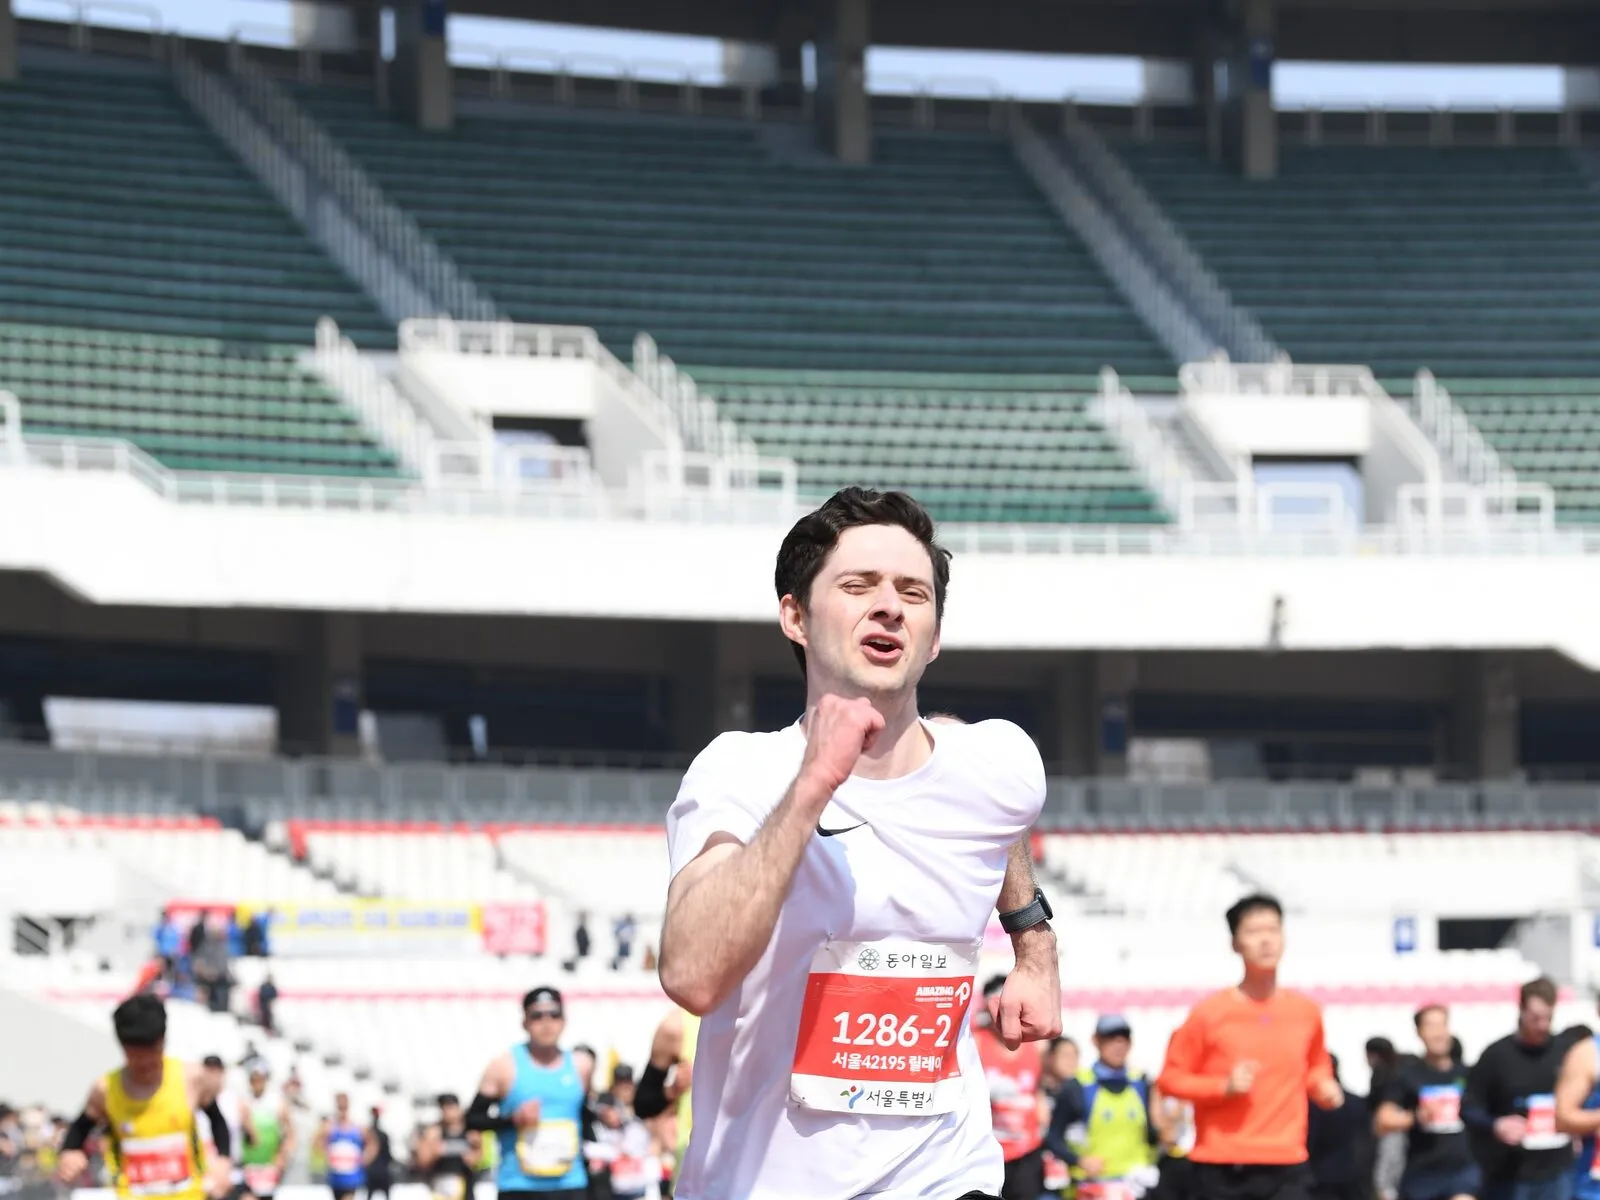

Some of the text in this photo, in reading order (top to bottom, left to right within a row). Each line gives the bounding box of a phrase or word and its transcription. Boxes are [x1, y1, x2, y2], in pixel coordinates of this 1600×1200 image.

[885, 953, 947, 969] 동아일보
[832, 1011, 951, 1048] 1286-2
[831, 1052, 906, 1070] 서울42195
